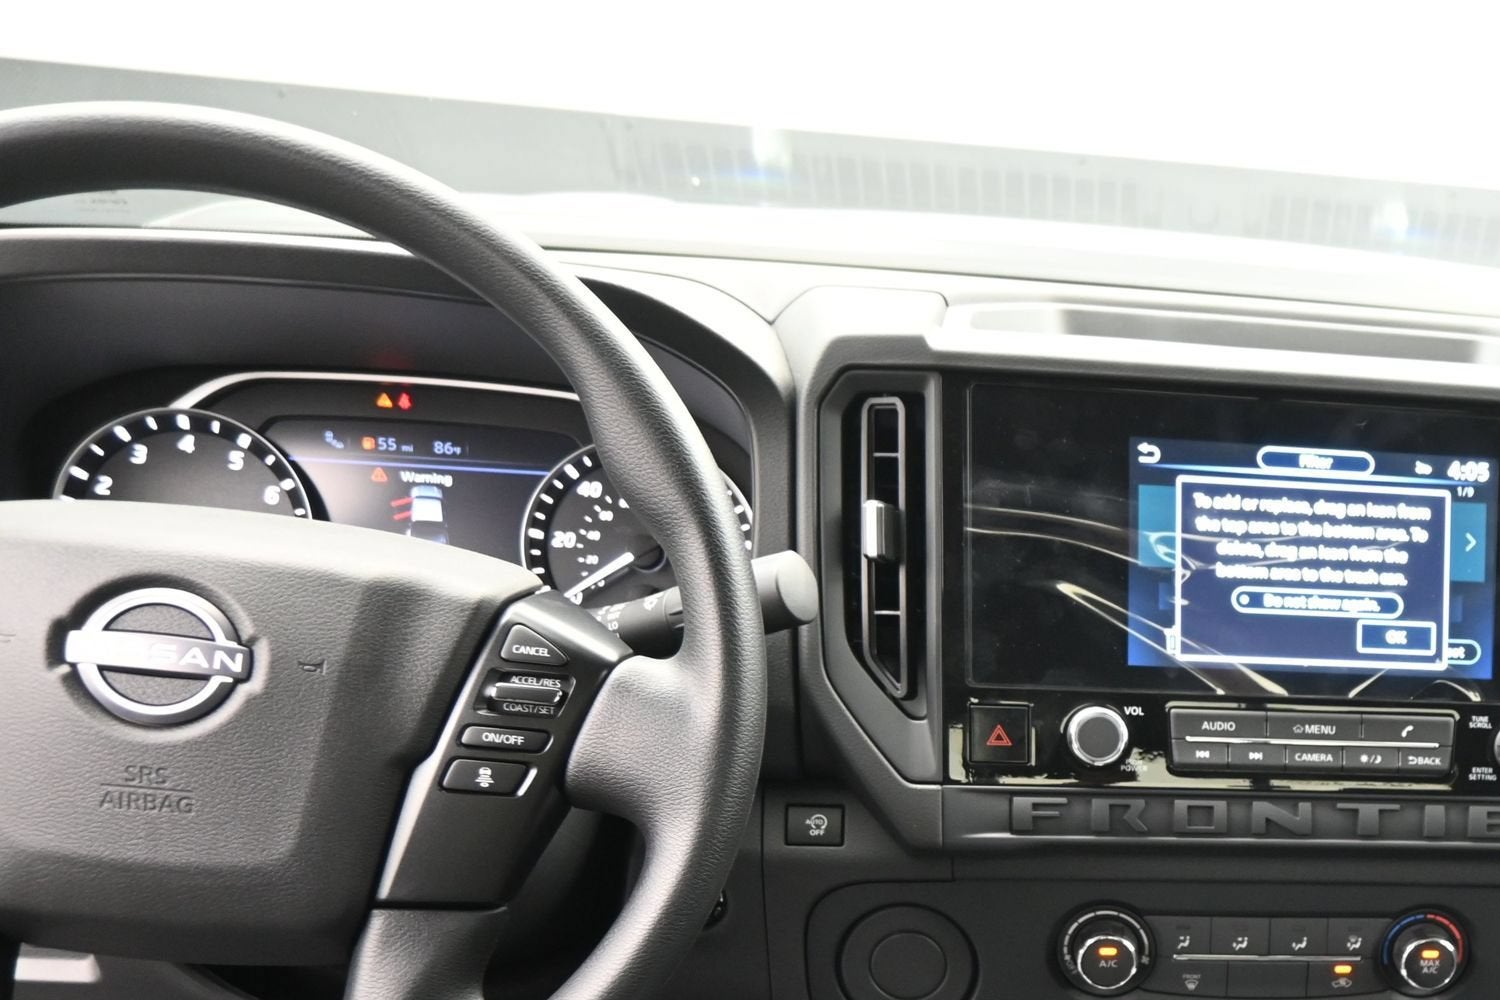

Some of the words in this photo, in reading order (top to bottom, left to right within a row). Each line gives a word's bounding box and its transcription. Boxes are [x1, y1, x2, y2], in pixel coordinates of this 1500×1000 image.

[176, 433, 196, 454] 4
[377, 437, 397, 451] 55
[129, 443, 149, 465] 3
[227, 450, 245, 471] 5
[1447, 460, 1490, 482] 4:05
[93, 474, 113, 496] 2
[399, 470, 453, 487] Warning
[263, 484, 281, 506] 6
[576, 480, 602, 499] 40
[1193, 492, 1212, 509] To
[1241, 498, 1259, 511] or
[551, 530, 576, 549] 20
[1385, 629, 1408, 645] OK
[512, 645, 551, 657] CANCEL
[510, 675, 561, 688] ACCEL/RES
[503, 702, 555, 715] COAST/SET
[1123, 706, 1145, 716] VOL
[1469, 721, 1493, 729] SCROLL
[1471, 715, 1489, 723] TUNE
[1201, 721, 1236, 731] AUDIO
[1304, 724, 1336, 735] MENU
[482, 732, 525, 745] ON/OFF
[1294, 752, 1334, 763] CAMERA
[1417, 756, 1442, 766] BACK
[124, 764, 169, 784] SRS
[1468, 773, 1497, 782] SETTING
[1472, 767, 1493, 775] ENTER
[100, 790, 194, 814] AIRBAG
[1099, 959, 1118, 968] A/C
[1420, 959, 1441, 967] MAX
[1422, 966, 1439, 974] A/C
